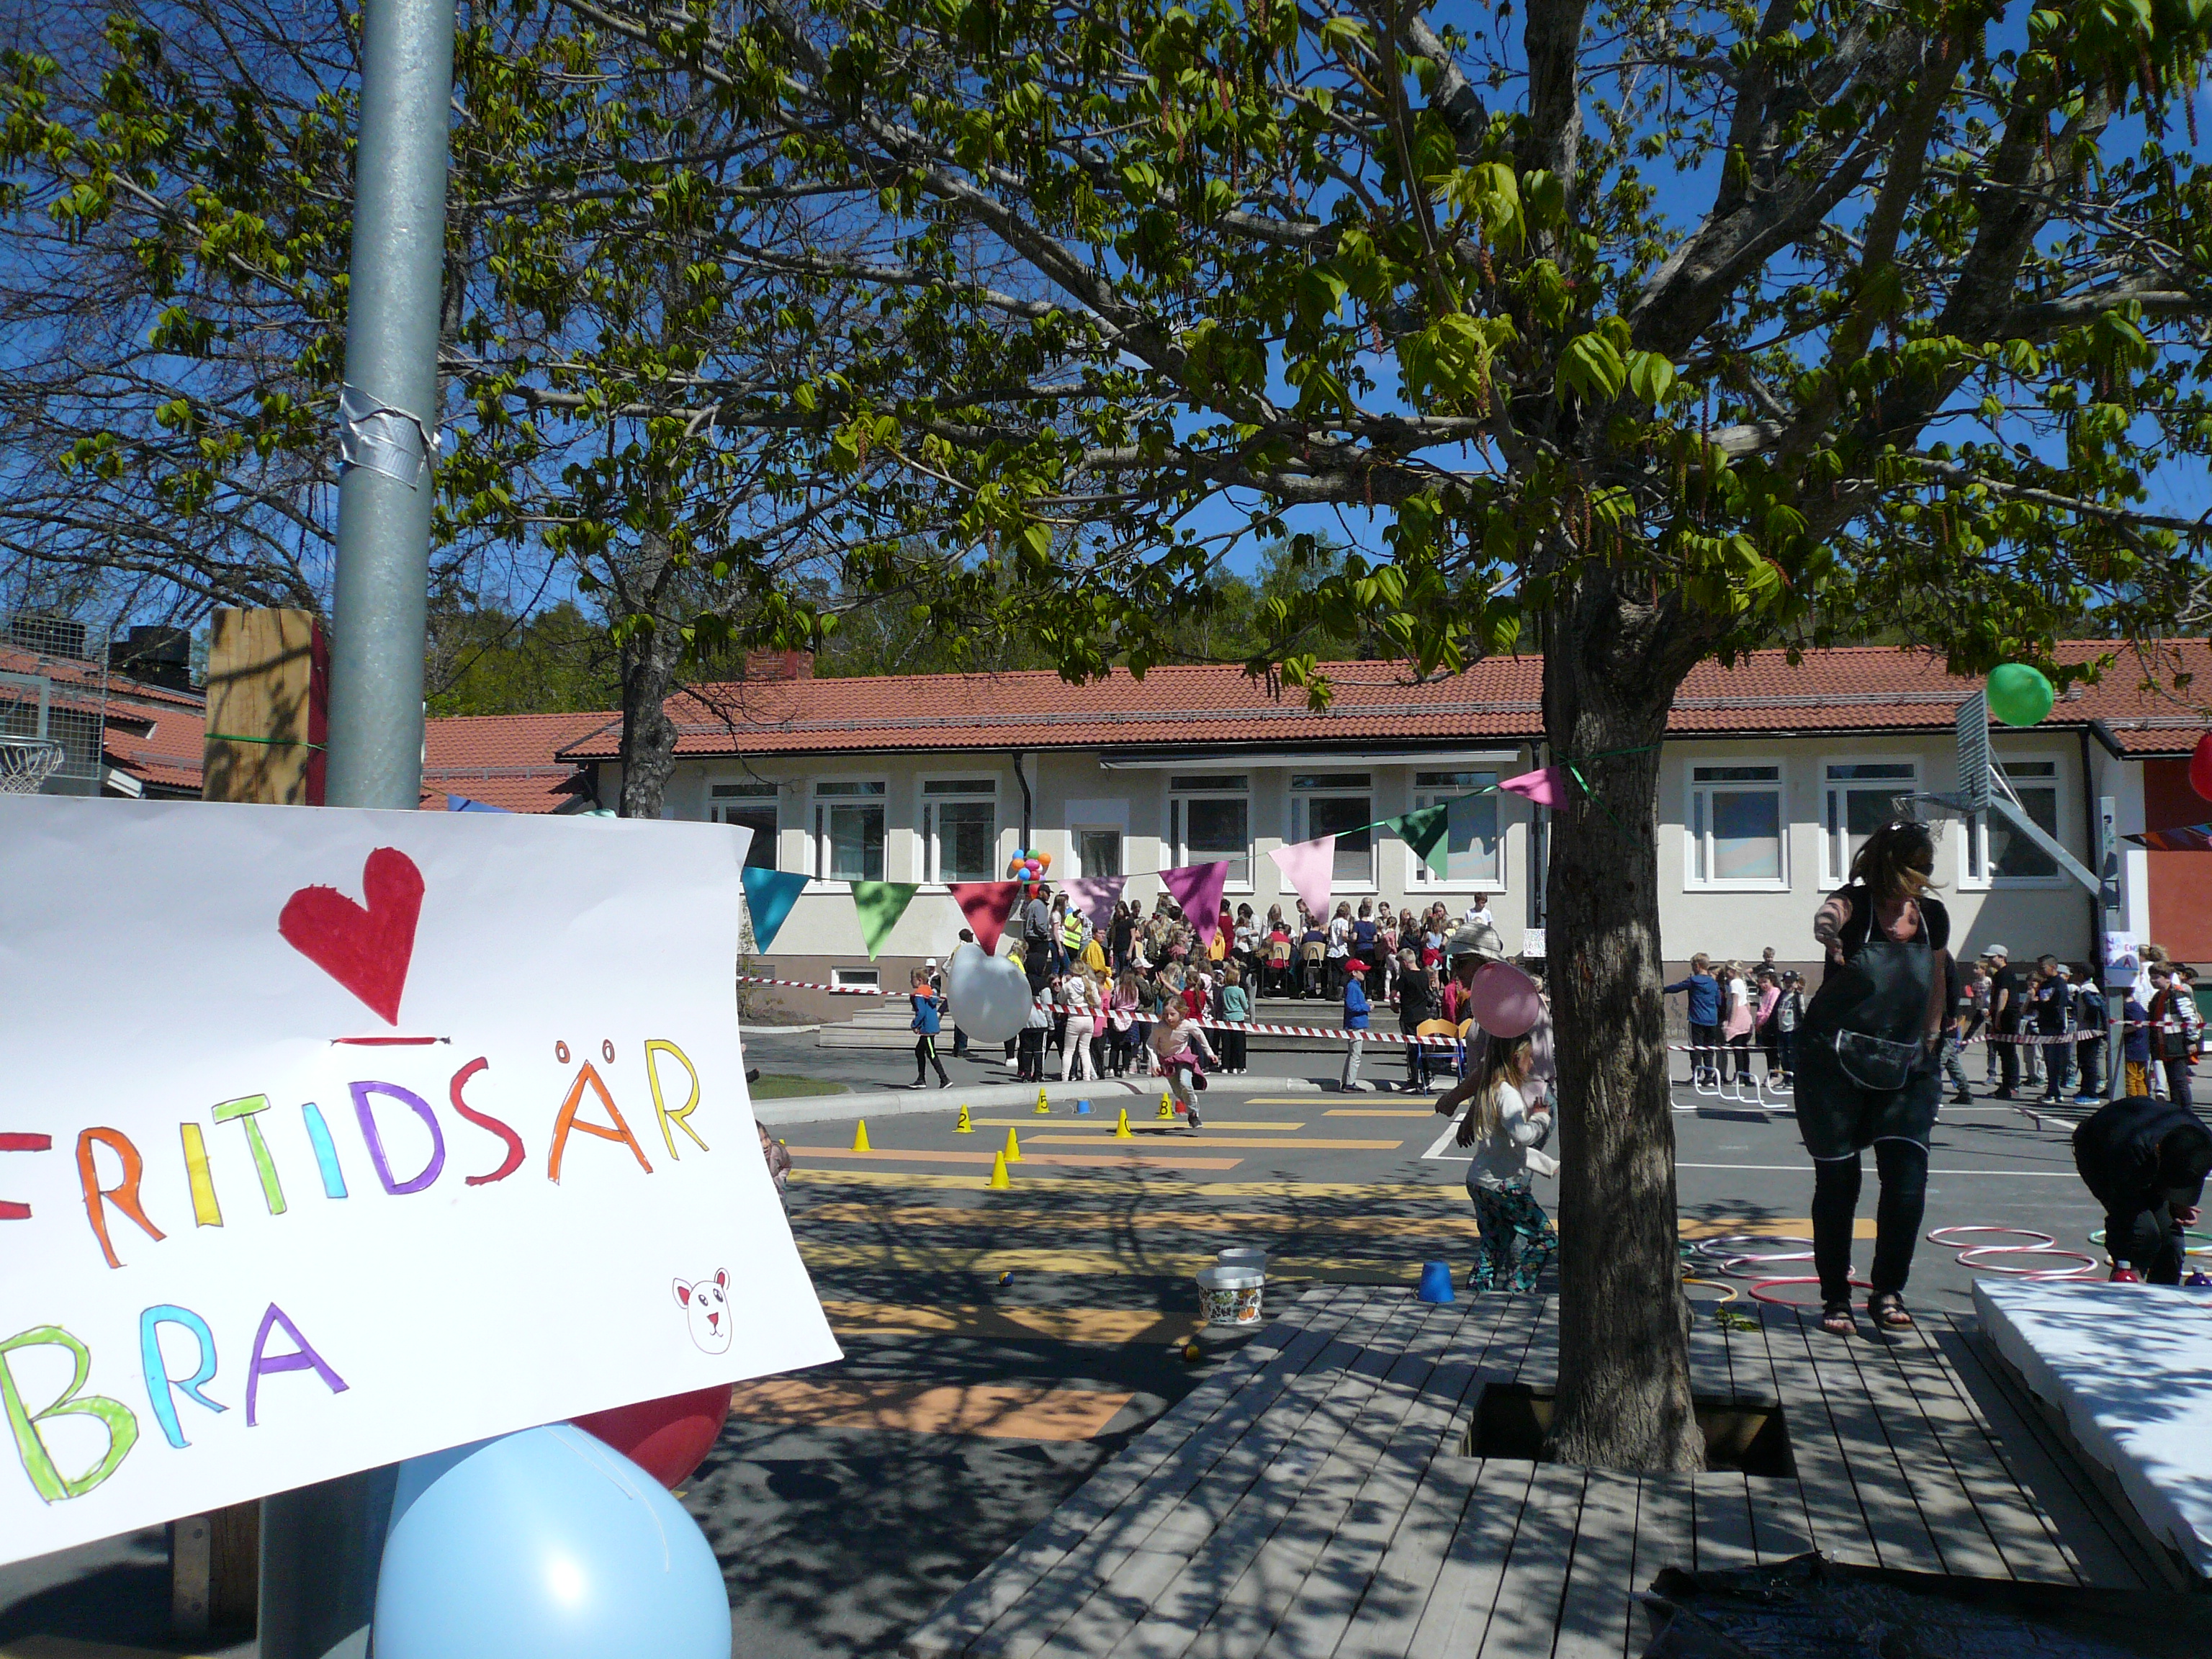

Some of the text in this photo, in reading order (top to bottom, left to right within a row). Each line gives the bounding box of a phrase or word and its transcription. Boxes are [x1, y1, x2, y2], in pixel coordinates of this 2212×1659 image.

[1040, 1095, 1048, 1109] 5
[1160, 1100, 1168, 1115] 8
[957, 1113, 967, 1128] 2
[0, 1302, 349, 1506] BRA
